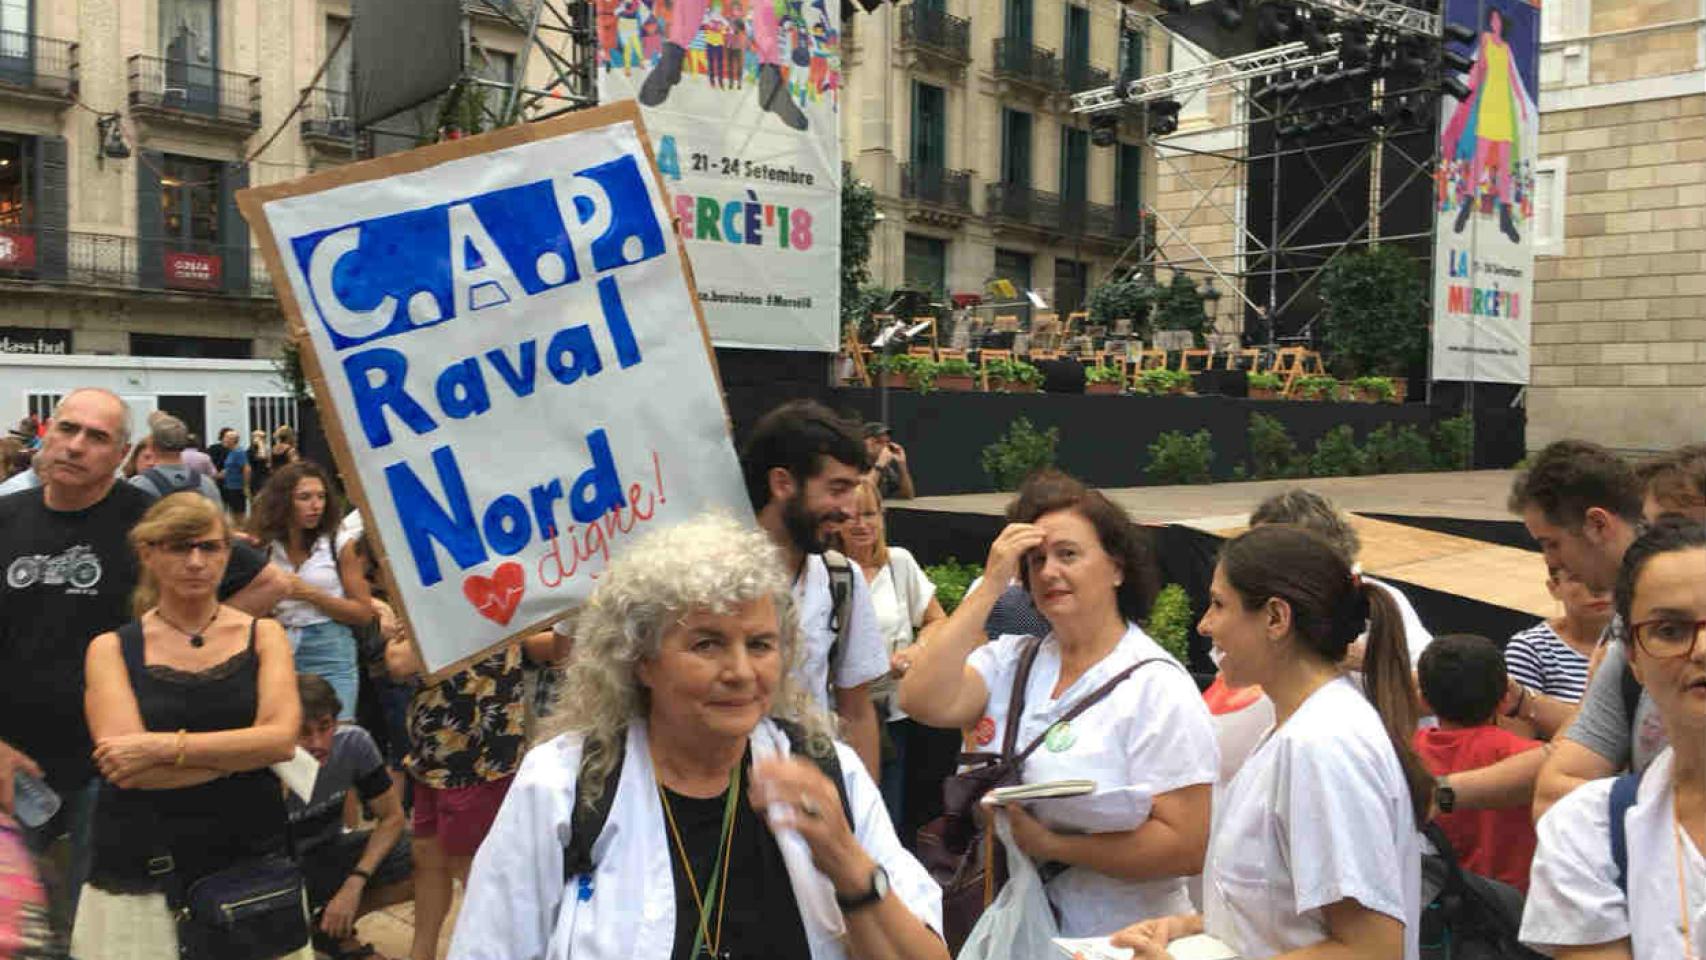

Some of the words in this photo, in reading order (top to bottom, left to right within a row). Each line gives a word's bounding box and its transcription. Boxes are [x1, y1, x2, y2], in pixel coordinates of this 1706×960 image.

[656, 134, 682, 180] A
[691, 152, 708, 173] 21
[721, 156, 740, 177] 24
[744, 160, 815, 186] Setembre
[307, 175, 648, 339] C.A.P.
[674, 188, 814, 253] ERCÈ'18
[1448, 249, 1469, 278] LA
[343, 275, 642, 448] Raval
[384, 428, 626, 587] Nord
[538, 450, 666, 588] digne!
